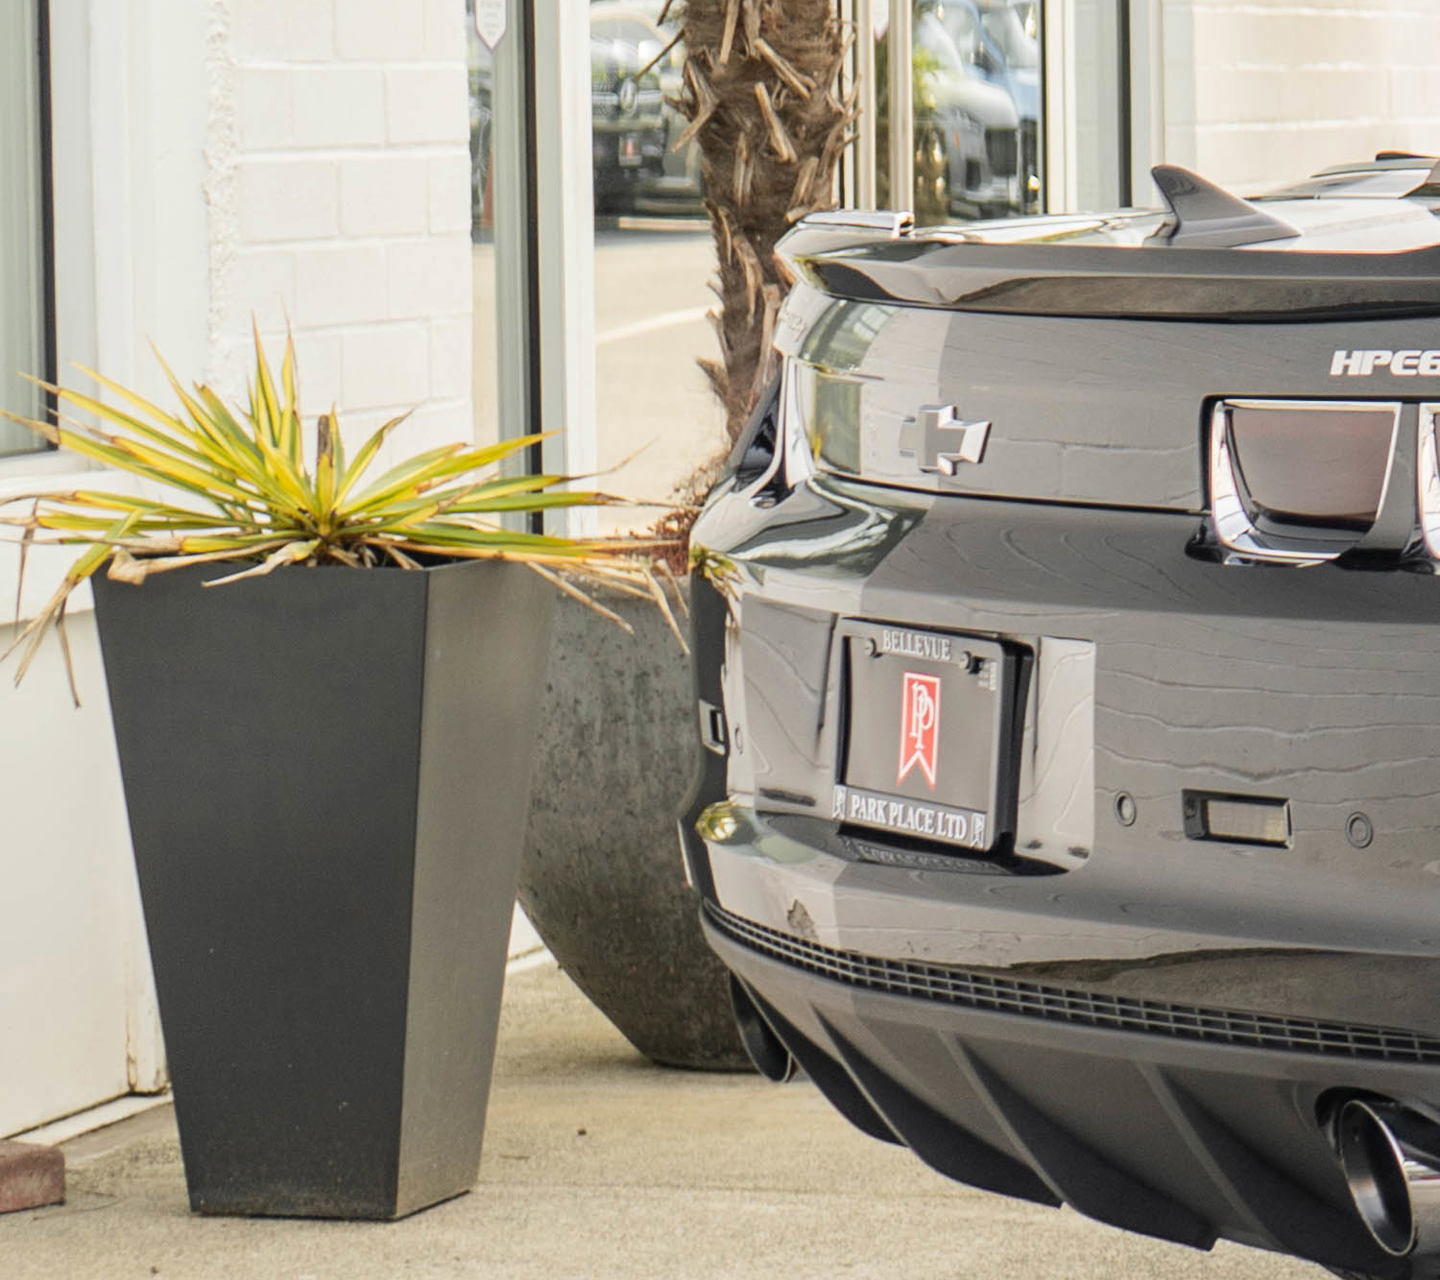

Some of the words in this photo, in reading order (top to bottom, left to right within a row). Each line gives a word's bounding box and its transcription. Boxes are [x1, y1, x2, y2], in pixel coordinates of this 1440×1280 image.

[882, 630, 951, 660] BELLEVUE
[850, 794, 888, 823] PARK
[888, 802, 935, 834] PLACE
[936, 811, 968, 840] LTD
